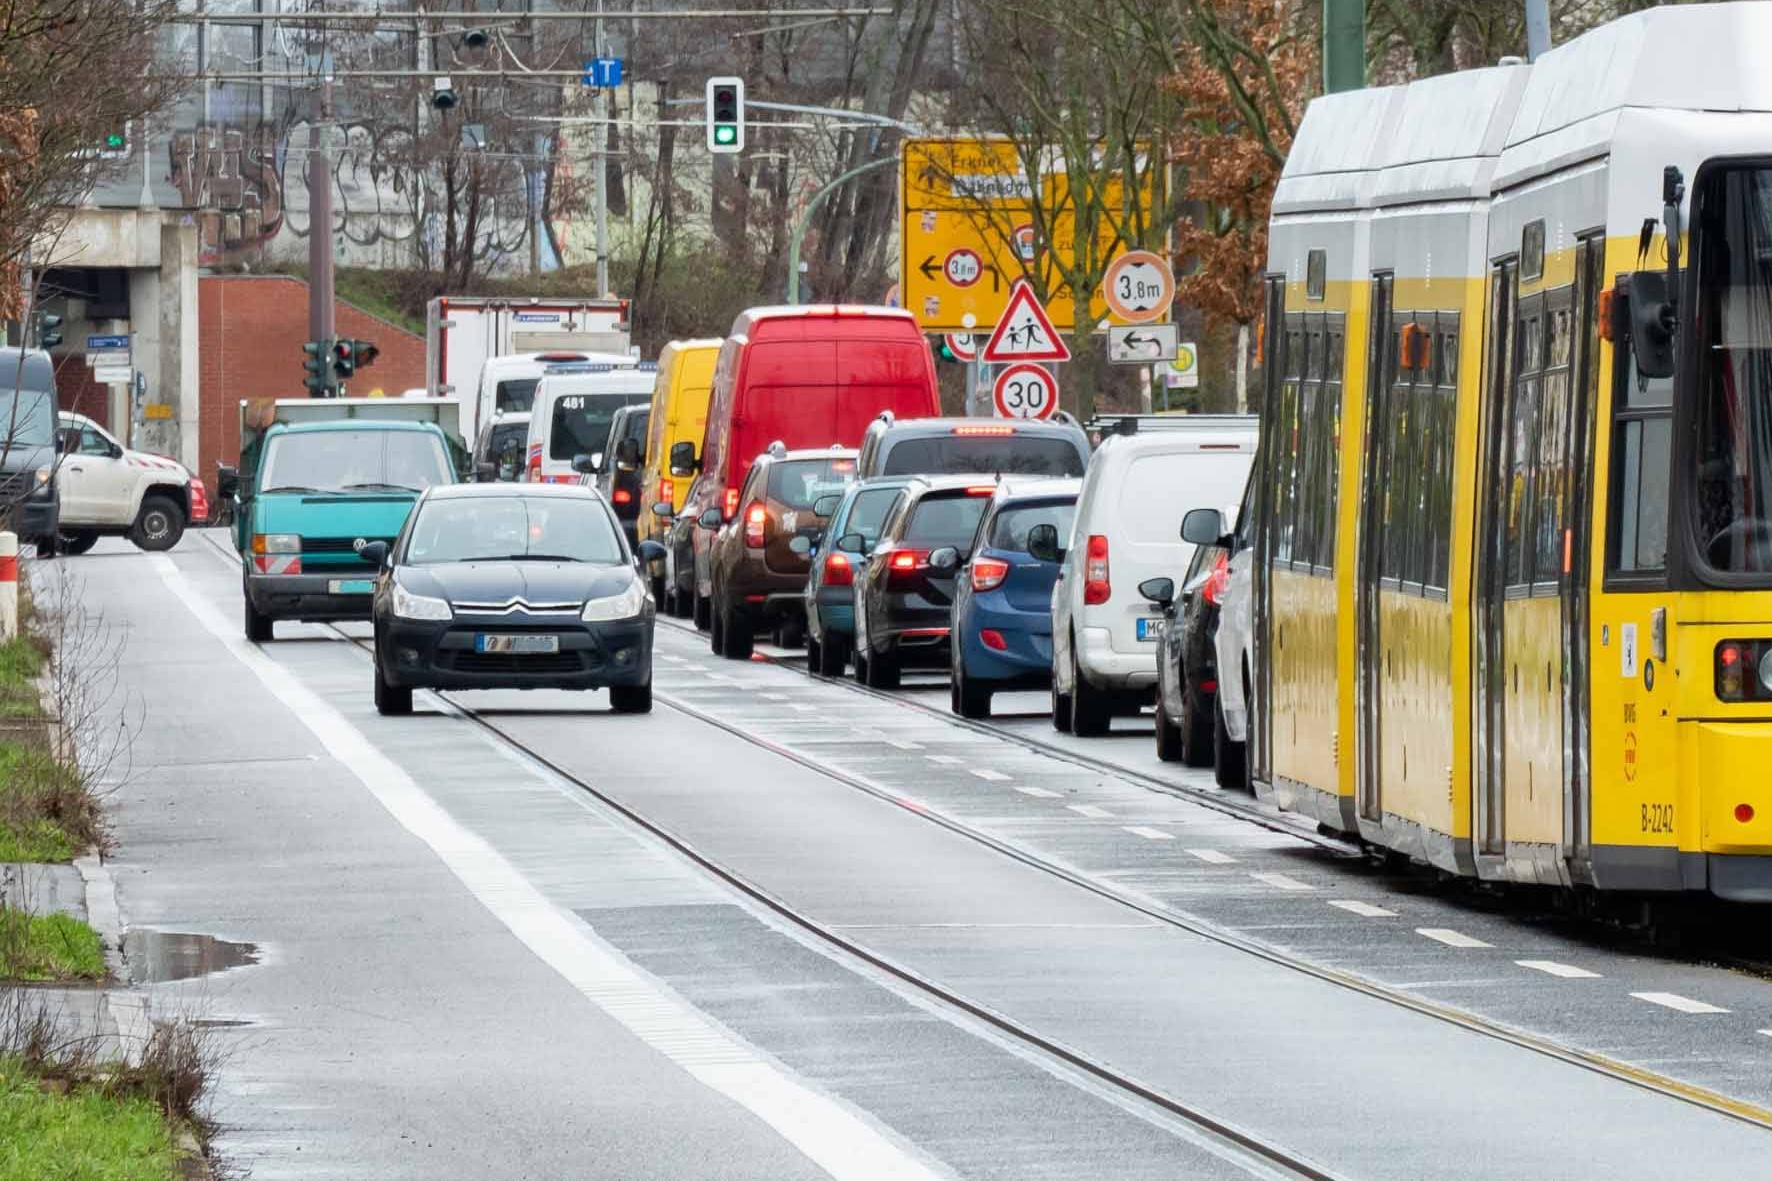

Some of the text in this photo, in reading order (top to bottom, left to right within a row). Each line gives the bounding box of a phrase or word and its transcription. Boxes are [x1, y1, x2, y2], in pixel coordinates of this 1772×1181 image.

[562, 396, 585, 409] 481
[1008, 381, 1042, 408] 30
[1641, 804, 1674, 832] B-2242
